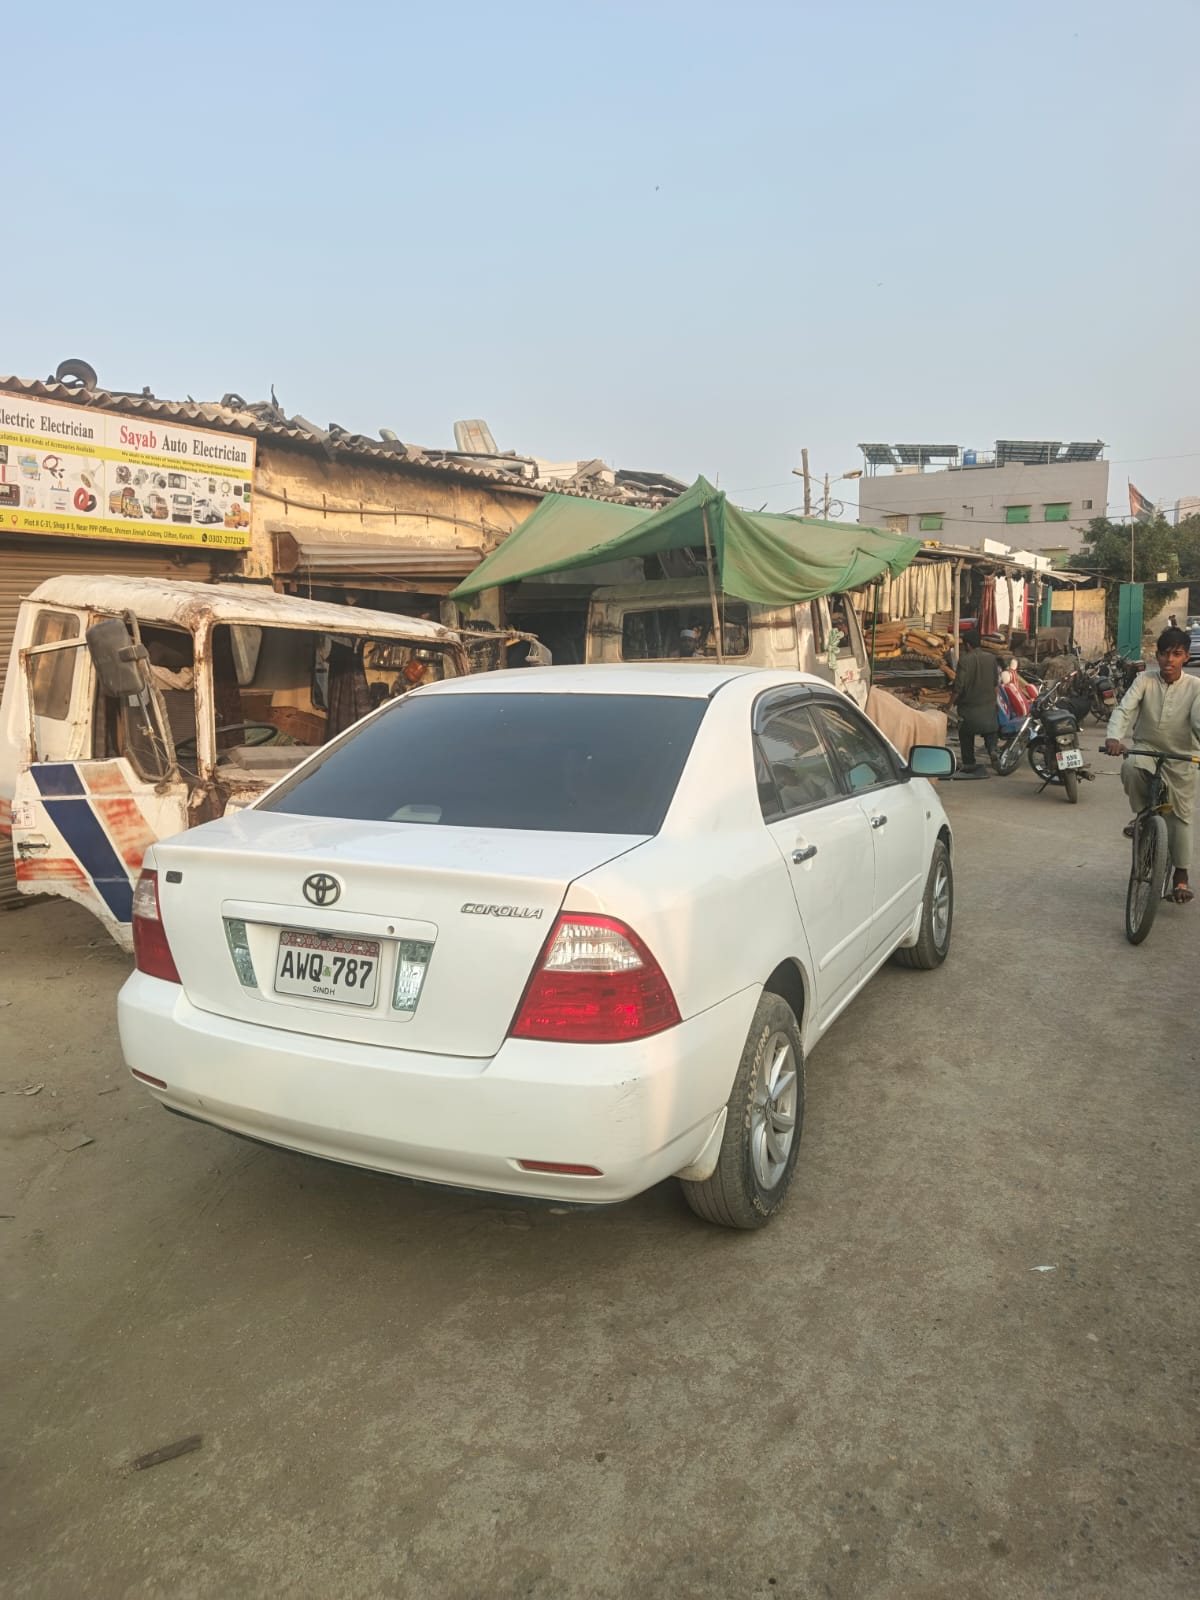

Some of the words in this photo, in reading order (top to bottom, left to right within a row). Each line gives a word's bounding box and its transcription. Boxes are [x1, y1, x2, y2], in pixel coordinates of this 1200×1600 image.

[0, 408, 35, 430] lectric
[40, 415, 94, 439] Electrician
[120, 425, 157, 450] Sayab
[162, 435, 188, 454] Auto
[193, 440, 247, 463] Electrician
[24, 518, 34, 526] Plot
[54, 521, 65, 530] Shop
[460, 903, 544, 919] COROLLA
[280, 950, 324, 982] AWQ
[332, 956, 373, 989] 787
[312, 985, 335, 996] SINDH
